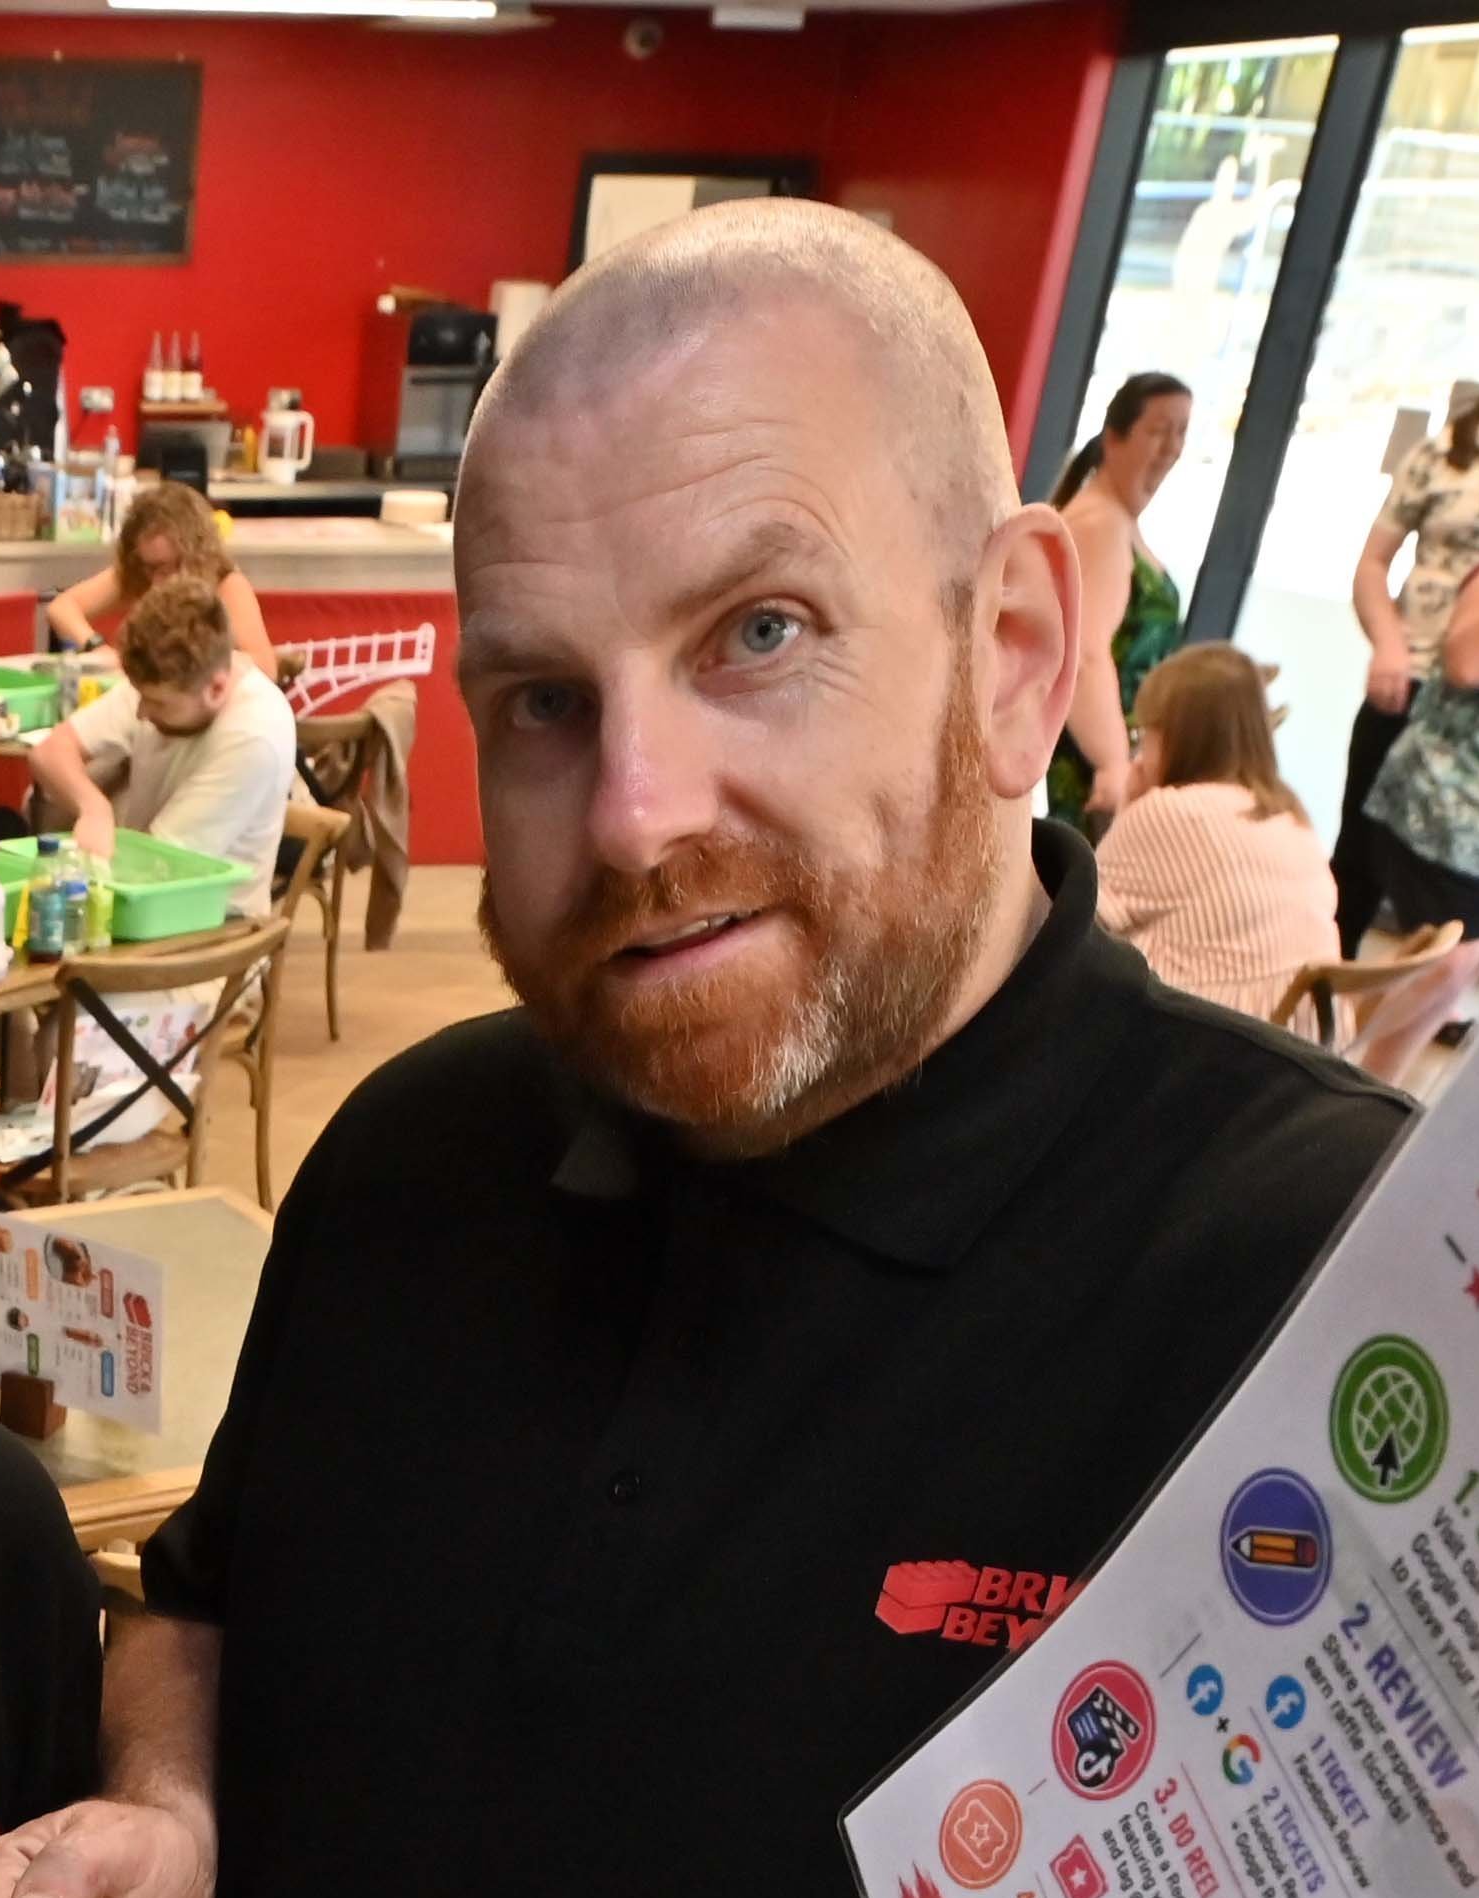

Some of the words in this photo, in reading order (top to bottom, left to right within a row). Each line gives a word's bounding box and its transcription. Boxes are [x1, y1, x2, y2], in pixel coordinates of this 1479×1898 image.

[1410, 1531, 1461, 1609] Google
[1432, 1505, 1467, 1561] Visit
[1405, 1579, 1445, 1639] leave
[1435, 1637, 1477, 1687] your
[1339, 1601, 1373, 1652] 2.
[1363, 1640, 1469, 1790] REVIEW
[1304, 1655, 1336, 1699] earn
[1329, 1700, 1366, 1752] raffle
[1361, 1751, 1412, 1825] tickets!
[1322, 1632, 1359, 1692] Share
[1351, 1692, 1388, 1736] your
[1382, 1738, 1450, 1846] experience
[1445, 1848, 1479, 1890] and
[1135, 1800, 1166, 1860] Create
[1154, 1777, 1179, 1815] 3.
[1168, 1811, 1197, 1849] DO
[1293, 1752, 1341, 1832] Facebook
[1334, 1829, 1371, 1889] Review
[1317, 1749, 1371, 1829] TICKET
[1102, 1827, 1121, 1859] and
[1118, 1812, 1158, 1896] featuring
[1246, 1803, 1288, 1877] Facebook
[1273, 1802, 1327, 1895] TICKETS
